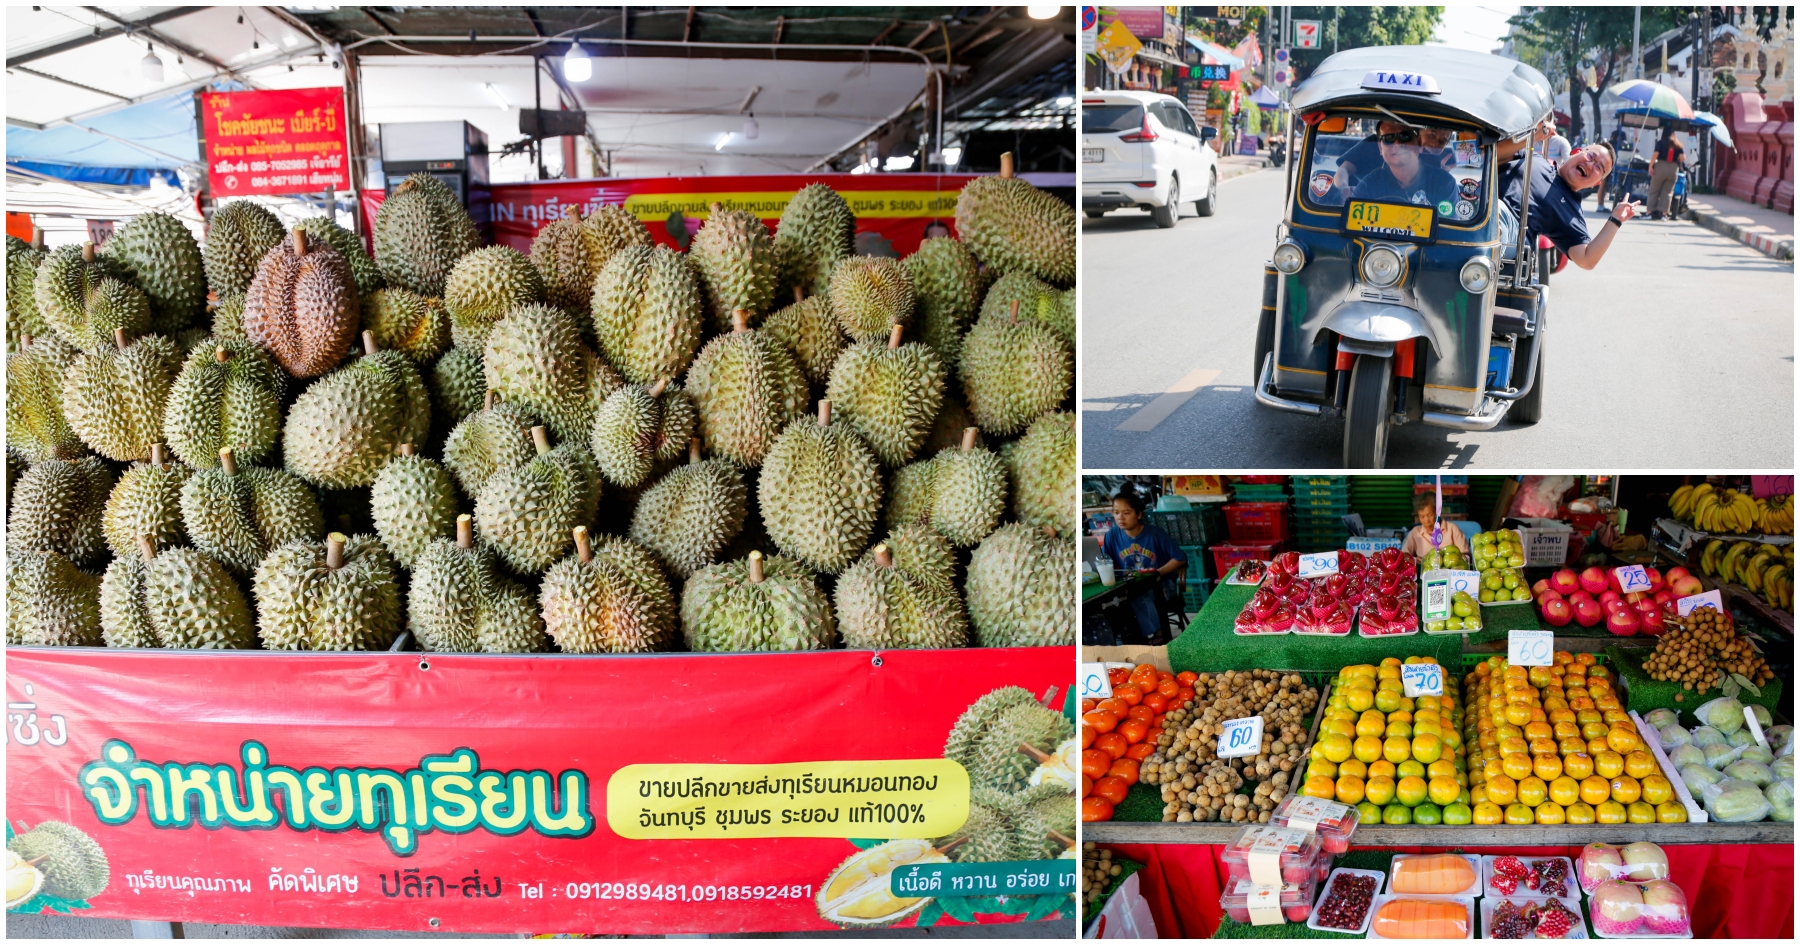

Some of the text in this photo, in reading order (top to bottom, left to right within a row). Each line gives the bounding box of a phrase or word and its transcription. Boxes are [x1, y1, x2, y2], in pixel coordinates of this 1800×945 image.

[1300, 25, 1315, 46] 7
[1376, 72, 1423, 87] TAXI
[209, 95, 230, 109] ร้าน
[214, 111, 285, 136] โชคชัยชนะ
[1313, 558, 1338, 570] 90
[1623, 570, 1648, 586] 25
[1520, 640, 1548, 661] 60
[1415, 673, 1439, 690] 70
[1230, 726, 1252, 748] 60
[639, 773, 938, 800] ขายปลีกขายส่งทุเรียนหมอนทอง
[78, 739, 594, 857] จำหน่ายทุเรียน
[639, 802, 925, 831] จันทบุรี ชุมพร ระยอง แท้100%
[125, 869, 251, 897] ทุเรียนคุณภาพ
[268, 867, 358, 893] คัดพิเศษ
[379, 867, 502, 898] ปลีก-ส่ง
[517, 882, 543, 899] Tel
[566, 882, 812, 902] 0912989481,0918592481
[899, 866, 942, 891] เนื้อดี
[952, 874, 997, 890] หวาน
[1006, 868, 1050, 888] อร่อย
